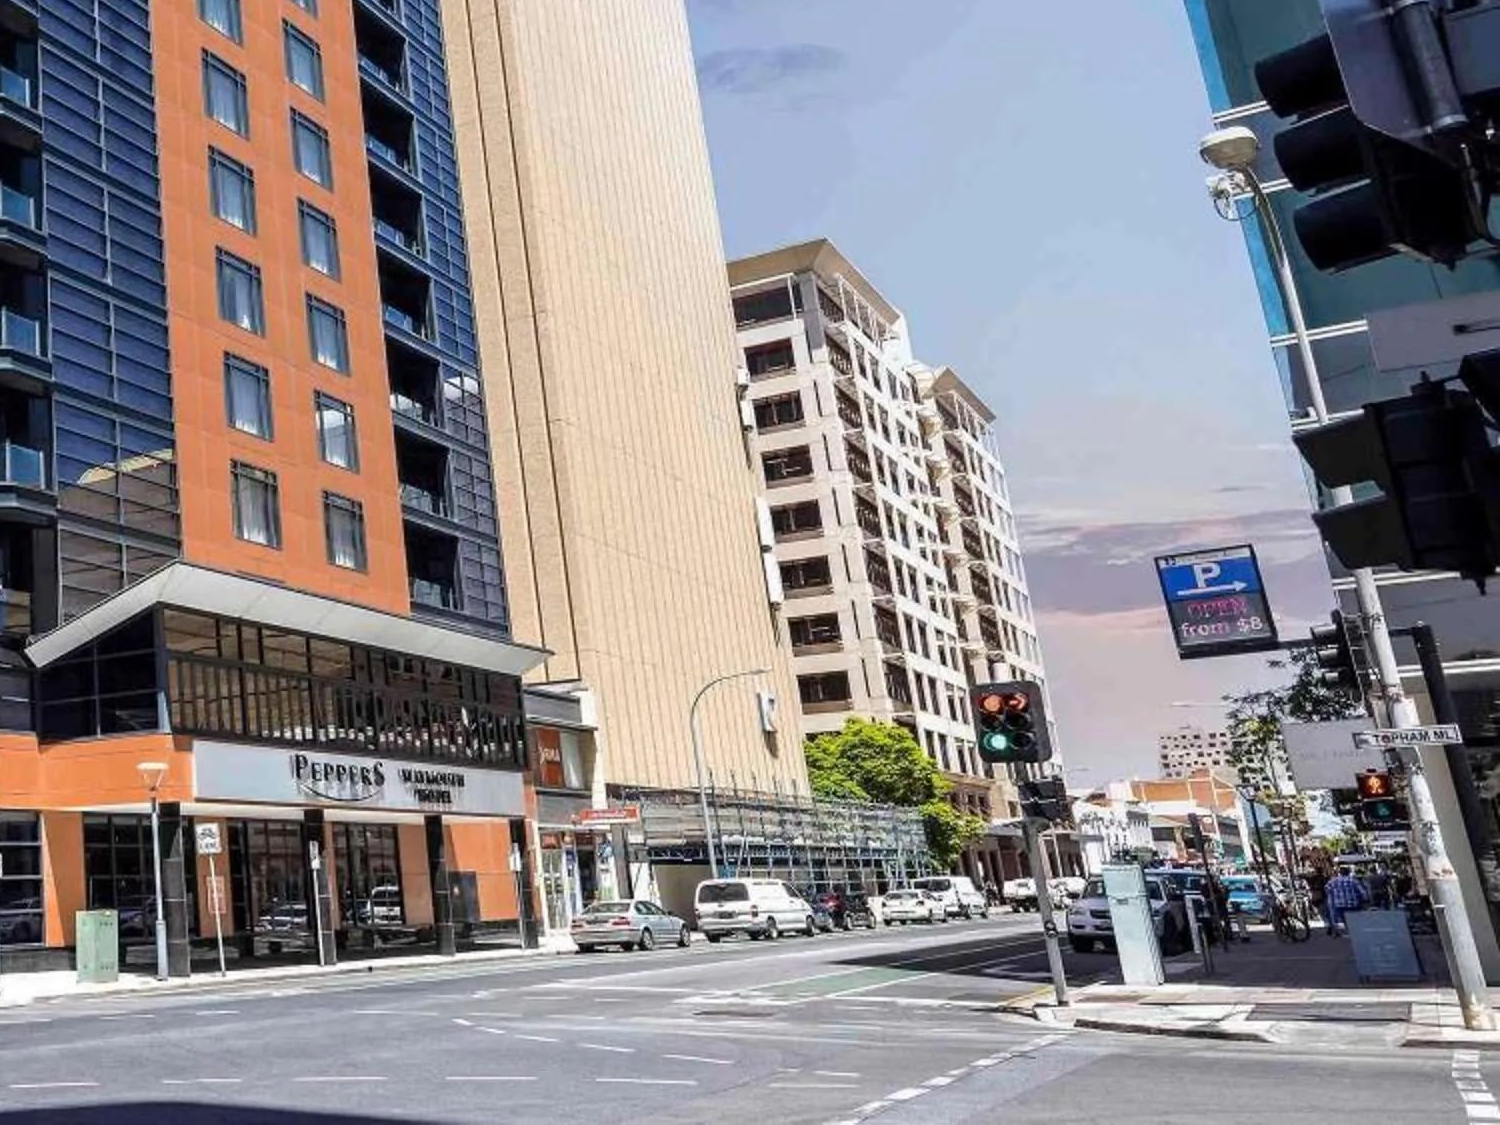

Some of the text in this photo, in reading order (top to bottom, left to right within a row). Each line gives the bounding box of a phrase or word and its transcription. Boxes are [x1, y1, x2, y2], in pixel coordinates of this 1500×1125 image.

[1193, 562, 1221, 588] P
[1181, 615, 1263, 638] from $8
[1373, 730, 1431, 745] TOPHAM
[294, 753, 386, 788] PEPPERS
